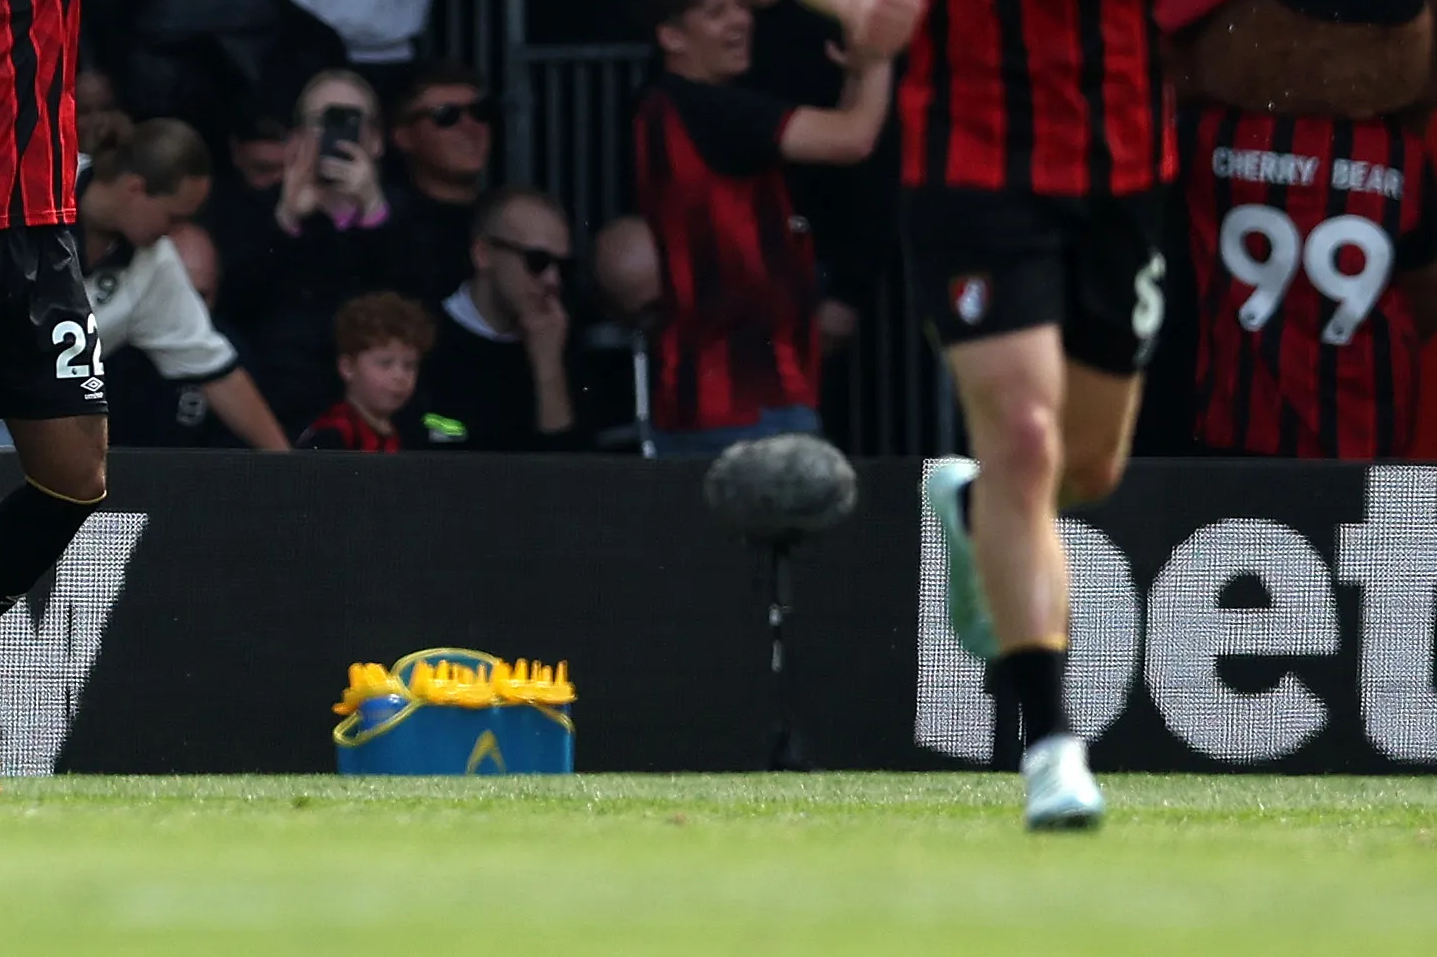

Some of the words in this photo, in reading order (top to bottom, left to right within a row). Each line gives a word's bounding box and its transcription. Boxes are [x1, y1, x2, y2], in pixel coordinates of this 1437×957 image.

[1213, 146, 1320, 187] CHERRY
[1331, 157, 1405, 201] BEAR
[1220, 203, 1396, 346] 99
